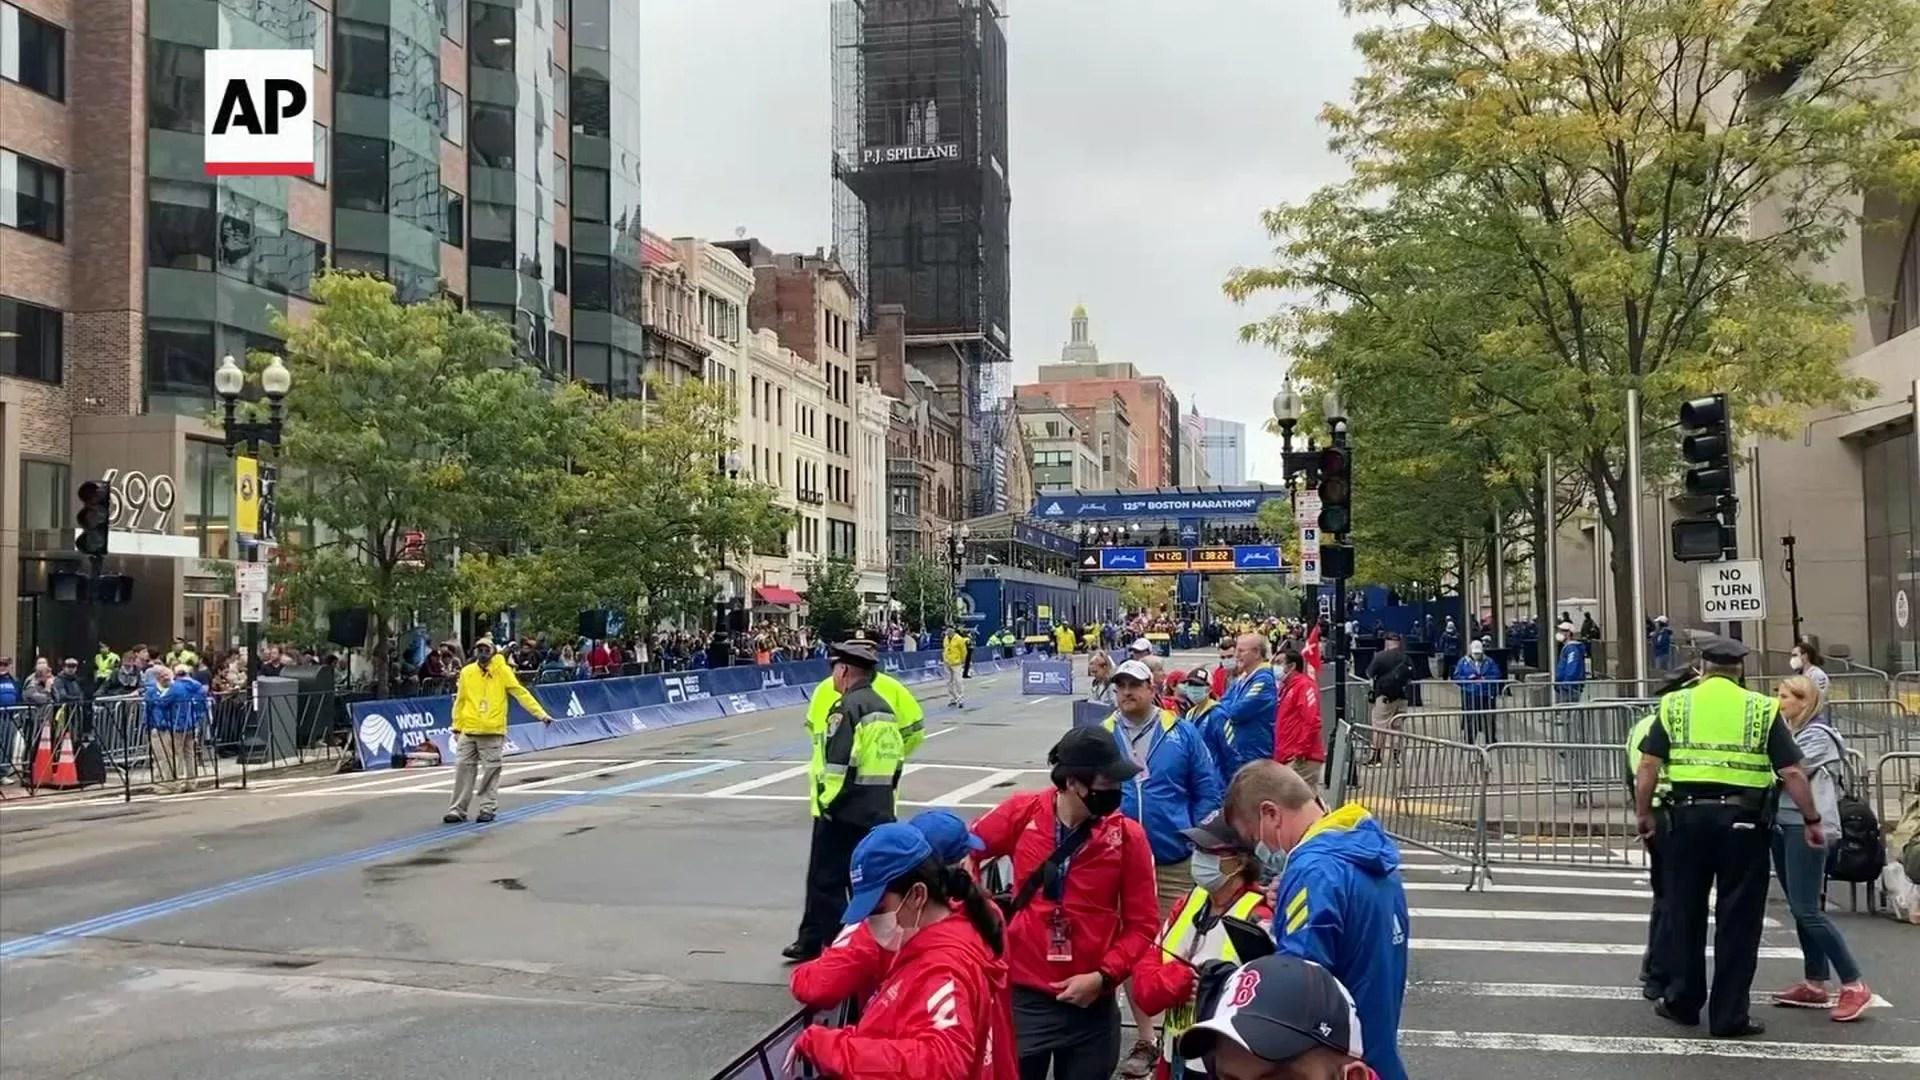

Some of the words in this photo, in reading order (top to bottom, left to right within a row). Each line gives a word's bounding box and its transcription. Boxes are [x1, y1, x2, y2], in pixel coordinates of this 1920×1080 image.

[863, 149, 884, 165] P.J.
[886, 144, 959, 161] SPILLANE
[1147, 500, 1190, 510] BOSTON
[1719, 568, 1741, 581] NO
[1711, 583, 1752, 596] TURN
[1704, 600, 1726, 612] ON
[1730, 598, 1761, 611] RED
[396, 711, 434, 730] WORLD
